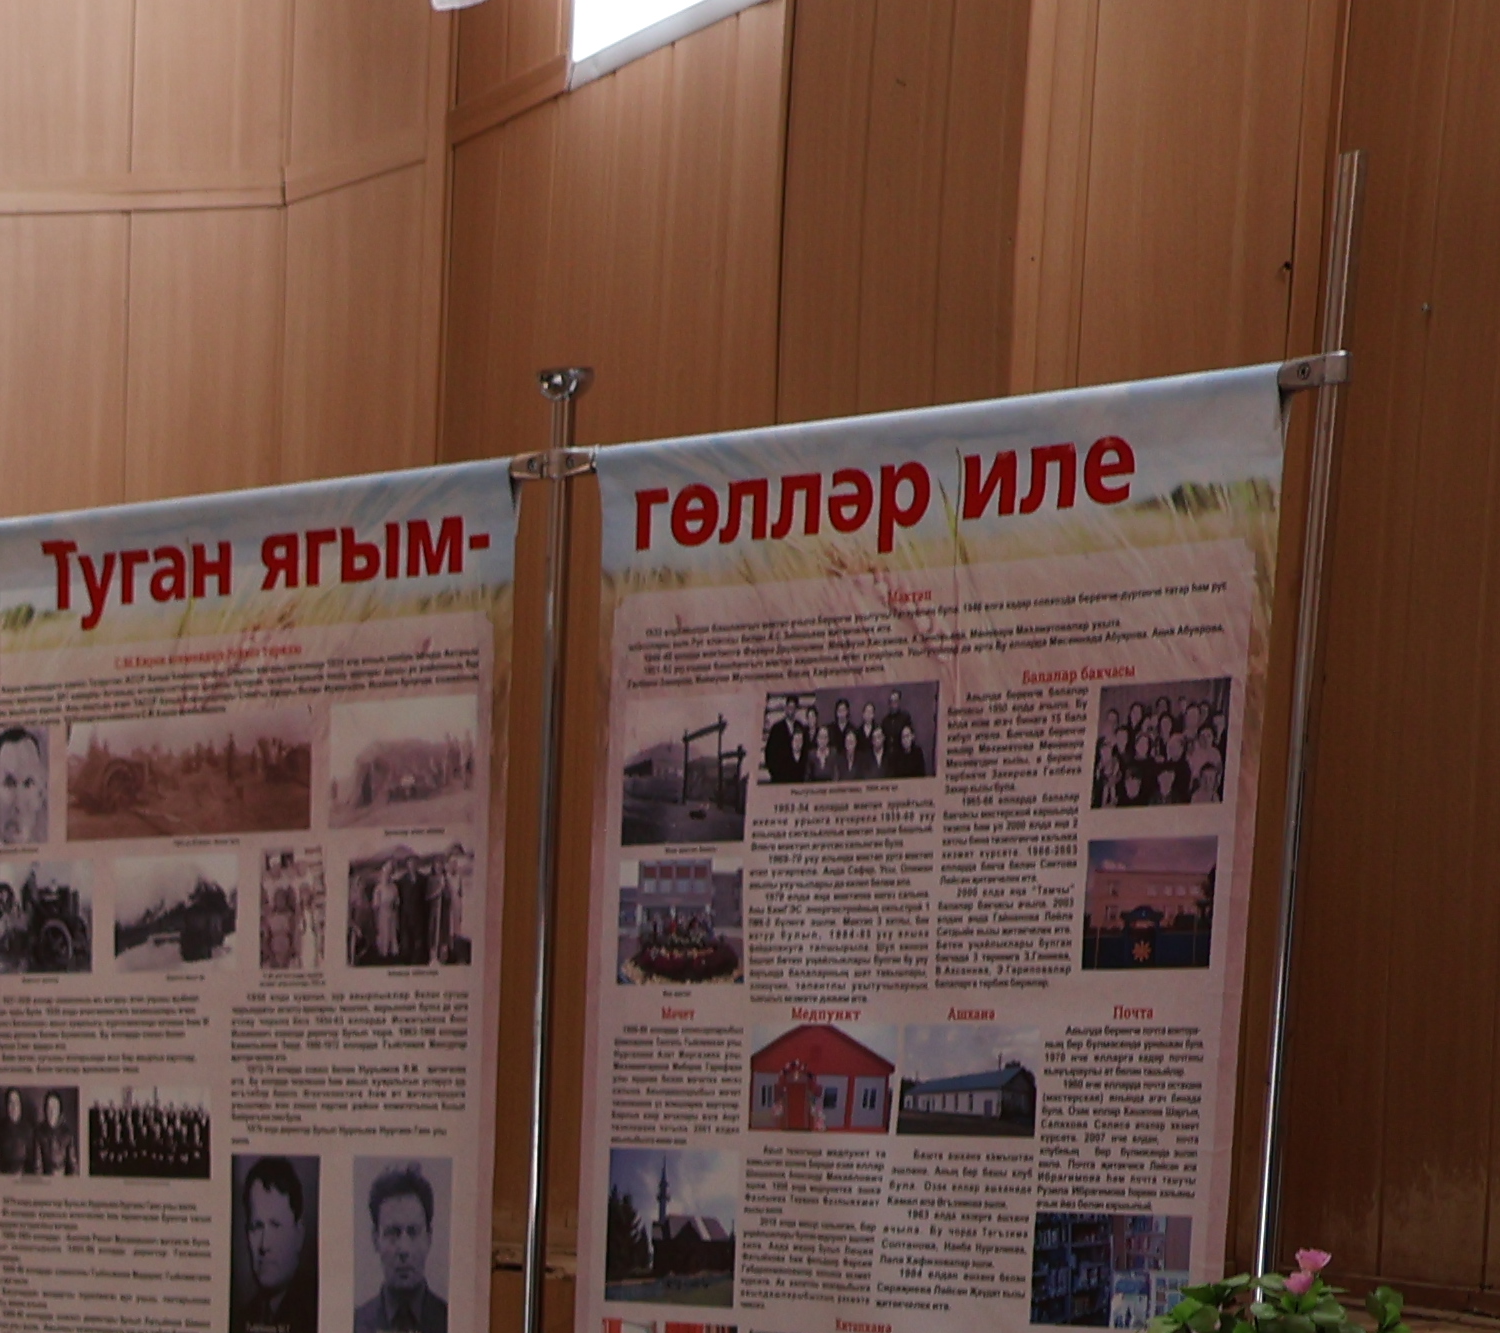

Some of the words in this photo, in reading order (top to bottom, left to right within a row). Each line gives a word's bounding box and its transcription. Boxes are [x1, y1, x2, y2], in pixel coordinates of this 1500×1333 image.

[634, 461, 931, 553] гөлләр
[962, 435, 1136, 520] иле
[42, 537, 233, 628] Туган
[261, 514, 491, 592] ягым-
[791, 1006, 862, 1023] Медпункт
[1113, 1005, 1154, 1021] Почта
